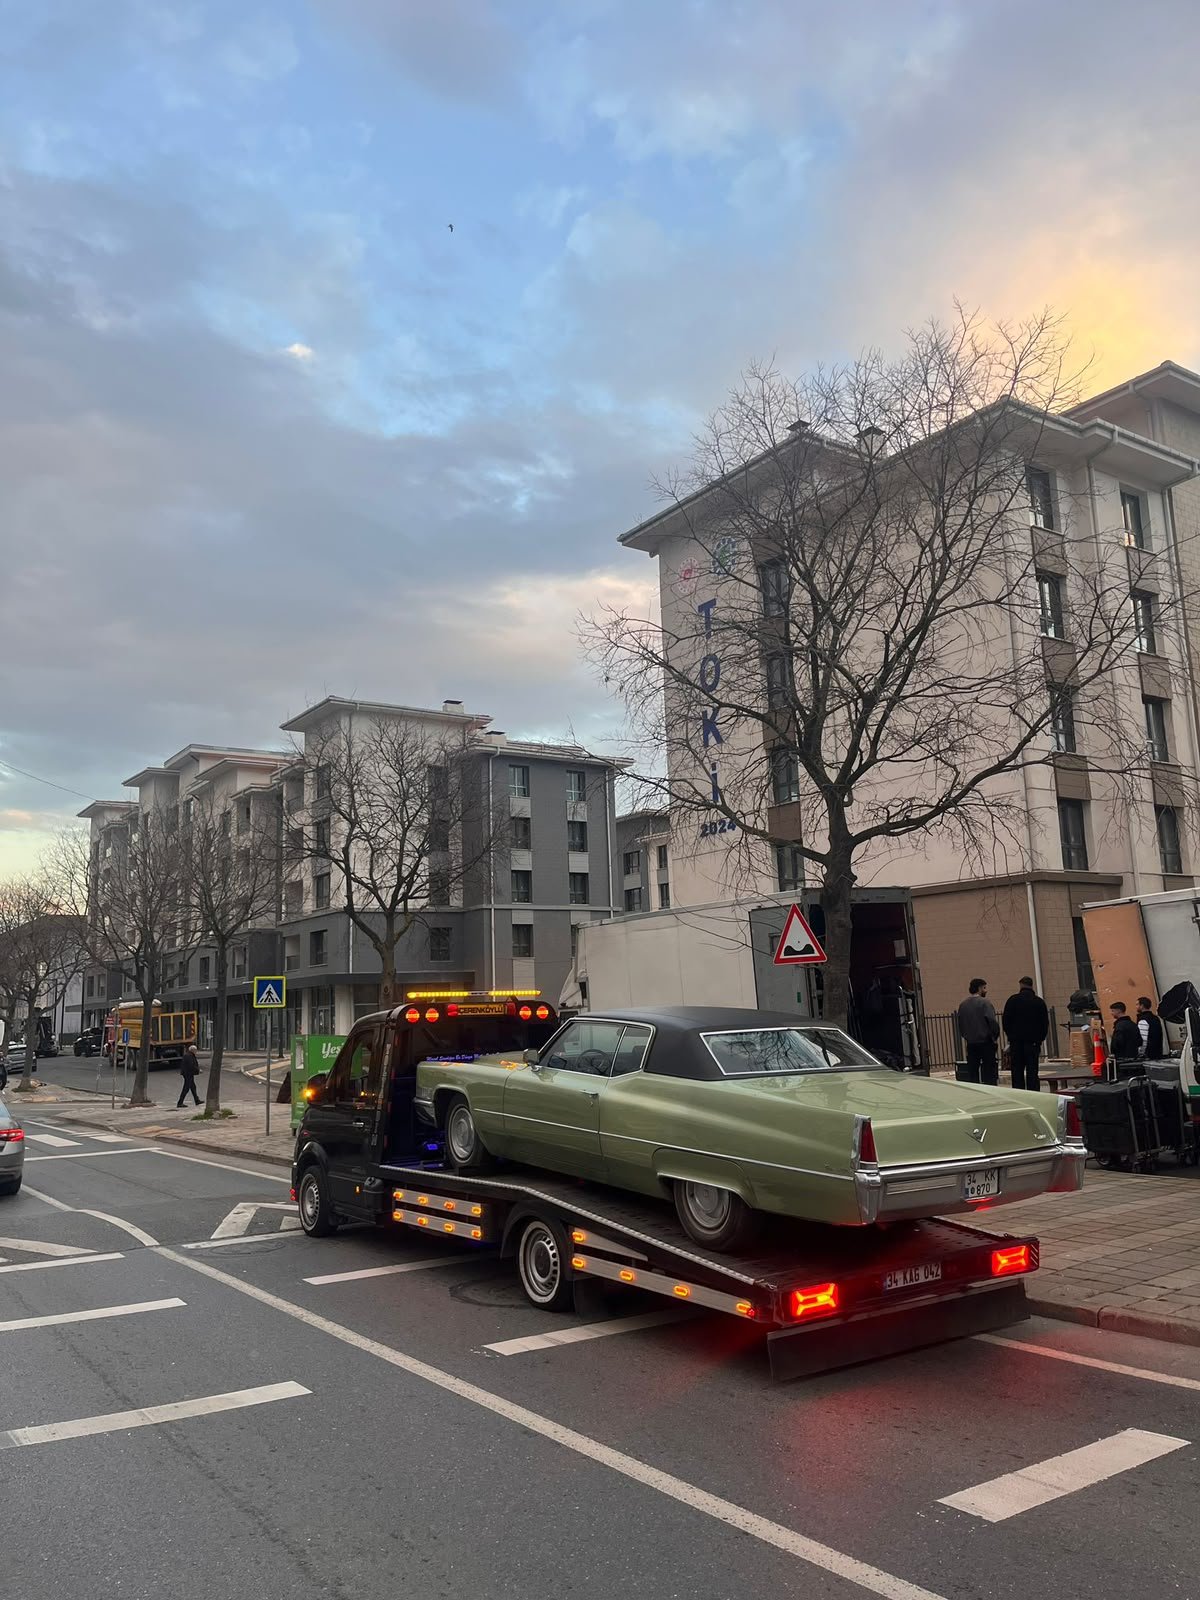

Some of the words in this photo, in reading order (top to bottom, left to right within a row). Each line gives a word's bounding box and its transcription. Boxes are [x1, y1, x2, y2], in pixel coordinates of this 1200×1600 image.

[701, 819, 737, 838] 2024
[967, 1173, 977, 1185] 34
[984, 1169, 996, 1182] KK
[976, 1183, 991, 1195] 870
[887, 1271, 898, 1288] 34
[923, 1263, 941, 1280] 042
